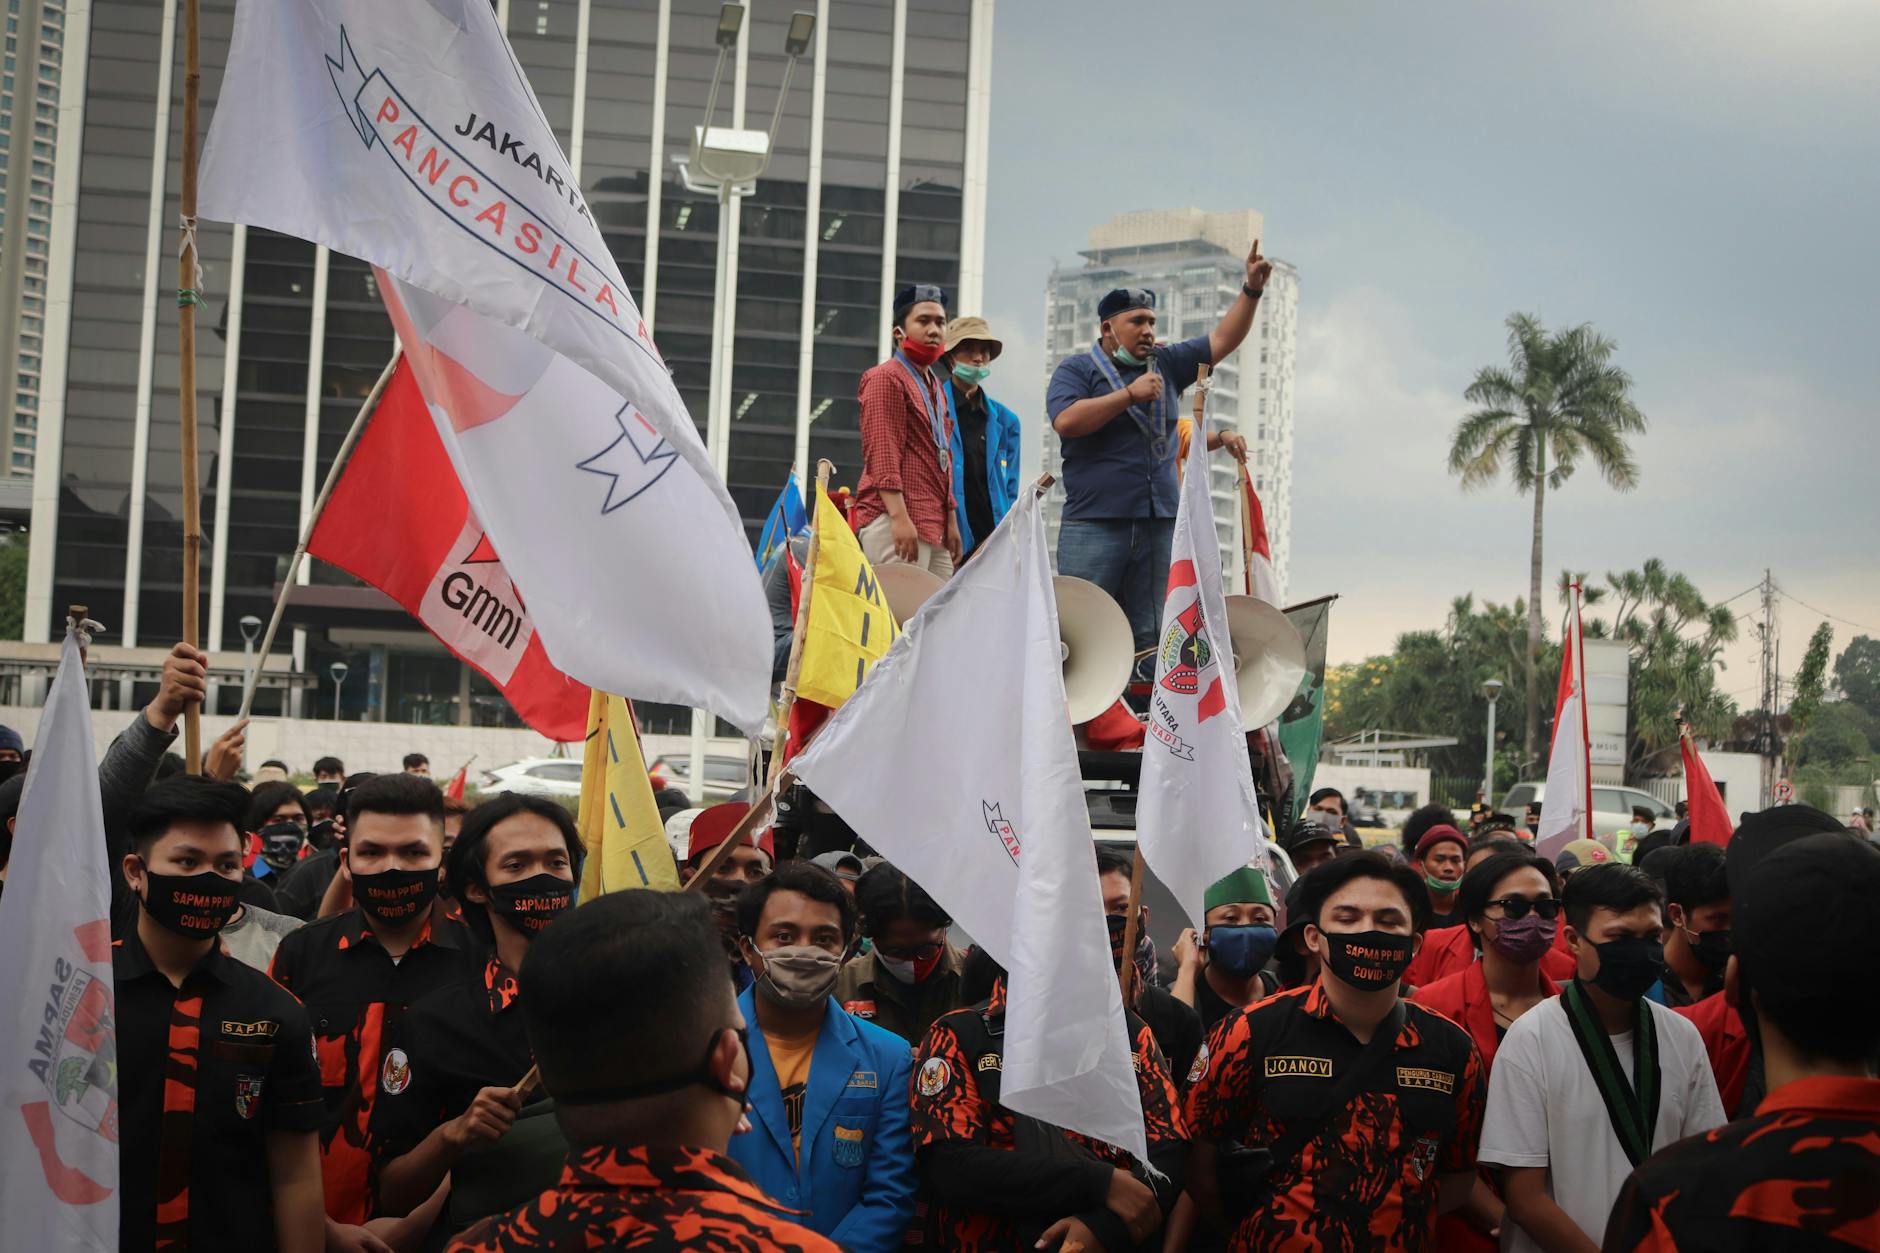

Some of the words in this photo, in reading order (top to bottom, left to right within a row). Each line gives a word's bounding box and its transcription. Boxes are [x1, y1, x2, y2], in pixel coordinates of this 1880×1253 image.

[455, 113, 597, 232] JAKARTA
[376, 96, 618, 316] PANCASILA
[1156, 697, 1179, 732] UTARA
[173, 891, 210, 907] SAPMA
[211, 896, 222, 909] PP
[368, 886, 397, 899] SAPMA
[515, 898, 550, 911] SAPMA
[551, 897, 561, 910] PP
[1345, 944, 1379, 960] SAPMA
[1381, 950, 1393, 961] PP
[1353, 965, 1395, 981] COVID-19
[1269, 1060, 1328, 1074] JOANOV
